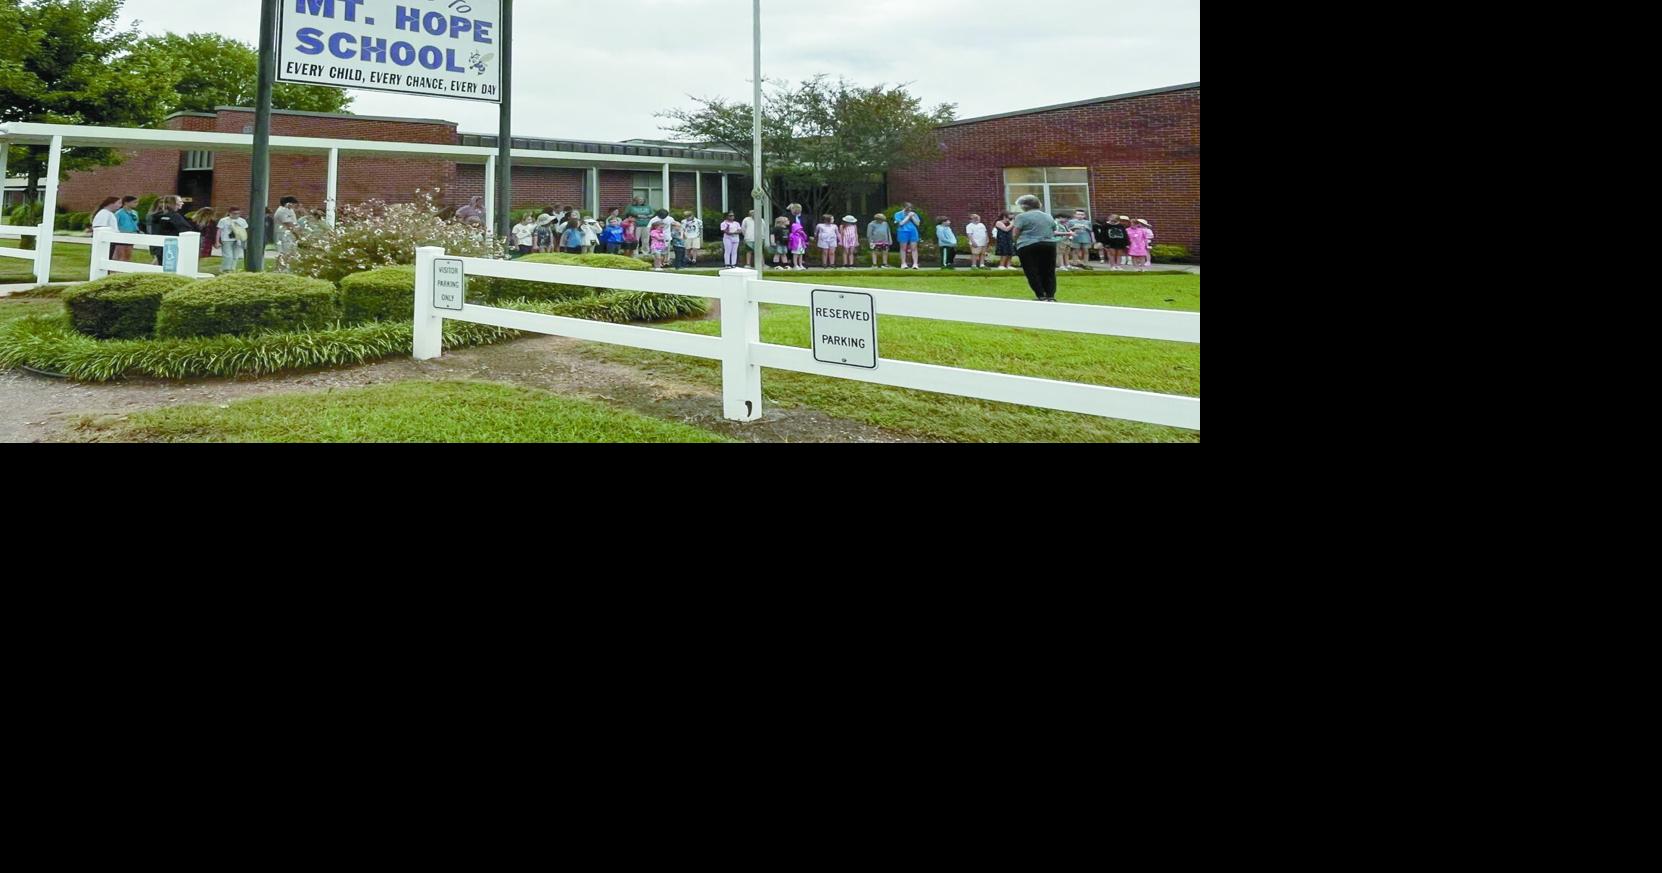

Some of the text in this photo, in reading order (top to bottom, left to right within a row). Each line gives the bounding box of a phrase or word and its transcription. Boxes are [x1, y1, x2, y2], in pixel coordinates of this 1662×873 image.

[295, 0, 493, 44] MT. HOPE
[295, 27, 465, 73] SCHOOL
[286, 61, 497, 96] EVERY CHILD, EVERY CHANCE, EVERY DAY
[438, 266, 459, 274] VISITOR
[437, 279, 459, 288] PARKING
[441, 293, 455, 301] ONLY
[815, 307, 870, 322] RESERVED
[822, 334, 865, 349] PARKING
